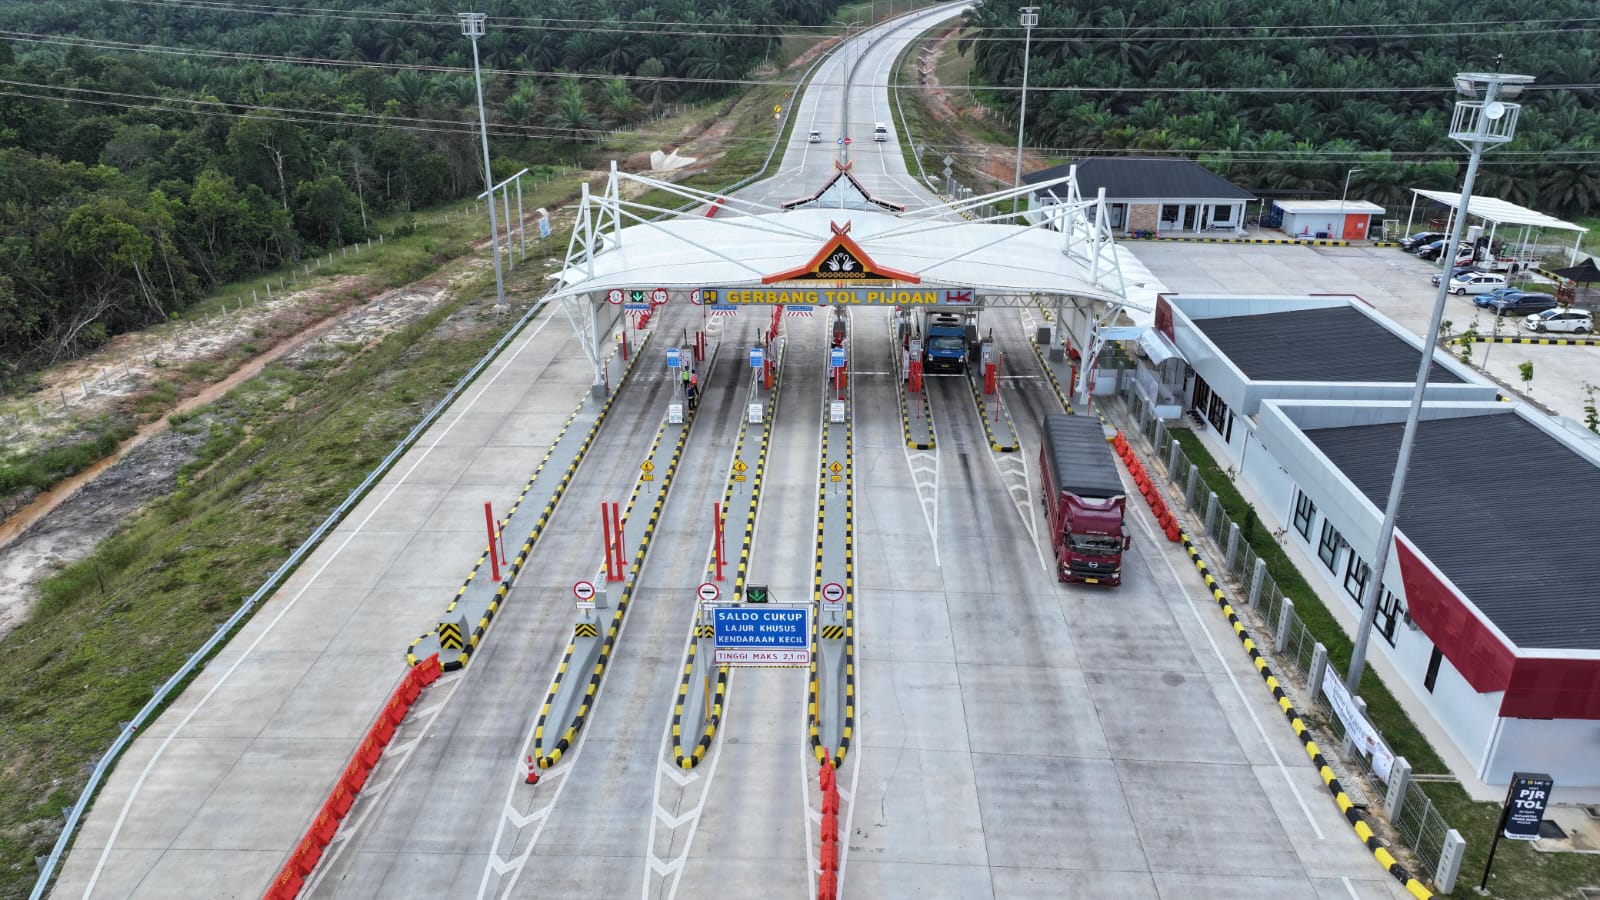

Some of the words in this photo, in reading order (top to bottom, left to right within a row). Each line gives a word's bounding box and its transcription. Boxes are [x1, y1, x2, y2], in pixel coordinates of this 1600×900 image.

[726, 291, 819, 304] GERBANG
[825, 291, 860, 304] TOL
[867, 291, 937, 304] PIJOAN
[718, 612, 759, 621] SALDO
[763, 613, 803, 621] CUKUP
[725, 624, 754, 632] LAJUR
[1519, 789, 1545, 800] PJR
[1514, 800, 1543, 809] TOL
